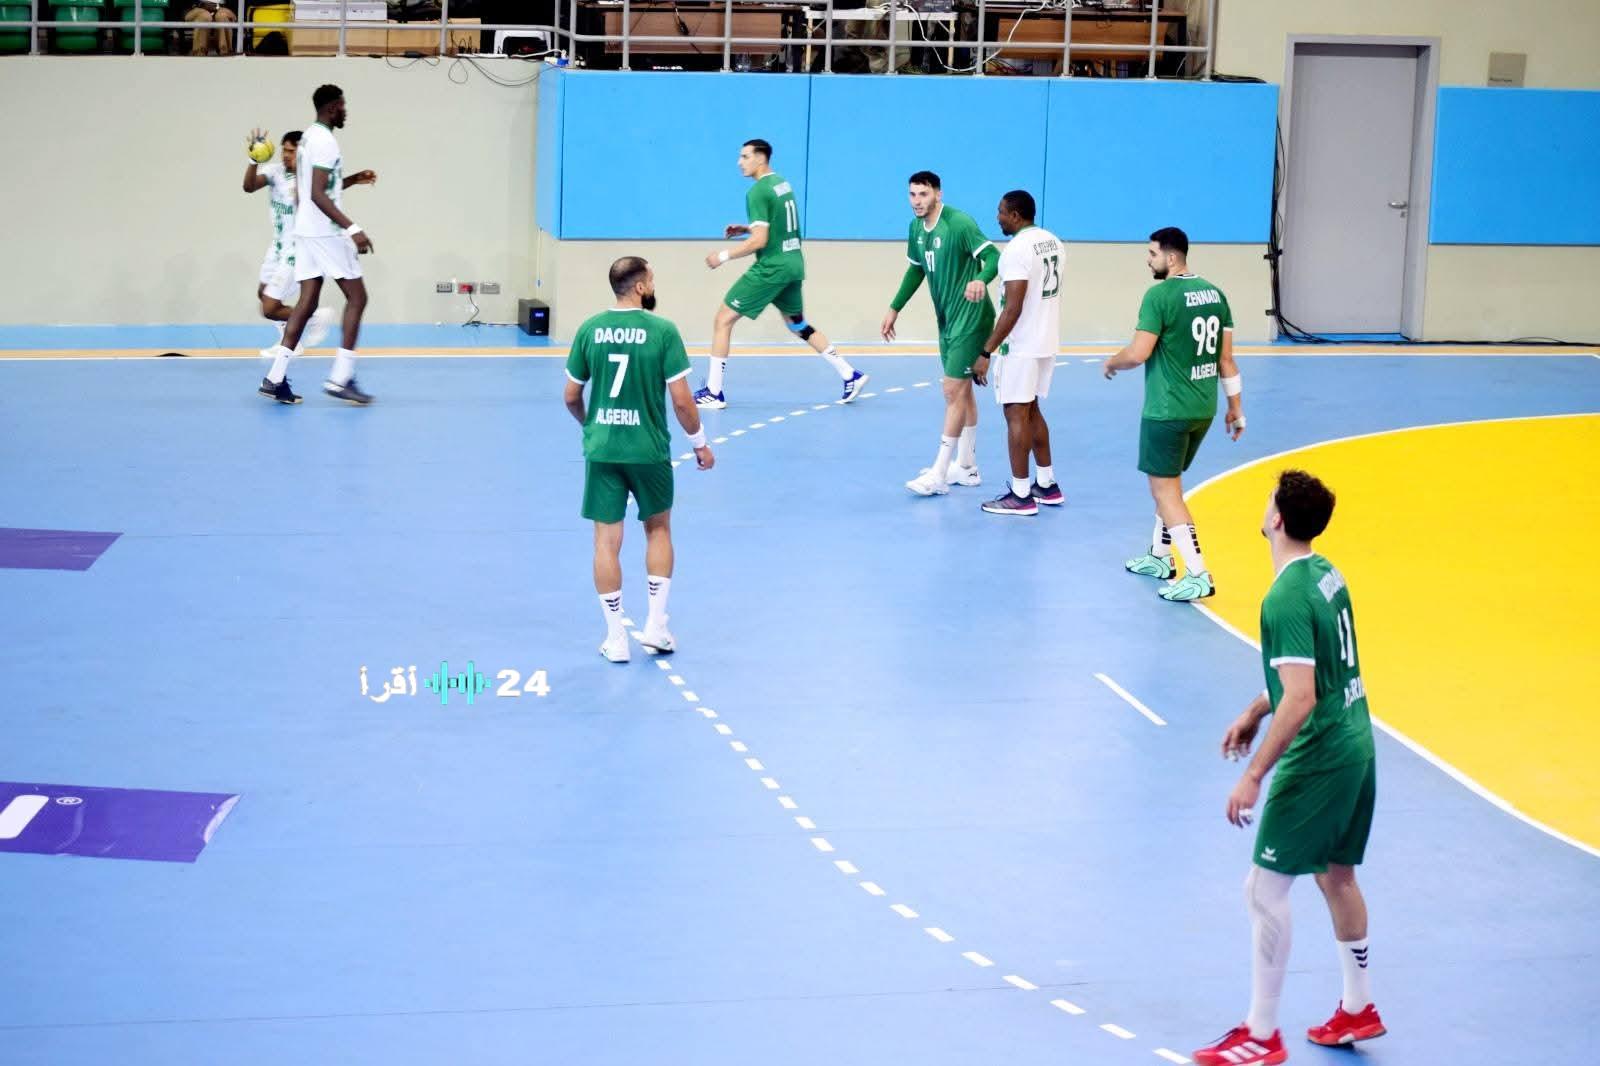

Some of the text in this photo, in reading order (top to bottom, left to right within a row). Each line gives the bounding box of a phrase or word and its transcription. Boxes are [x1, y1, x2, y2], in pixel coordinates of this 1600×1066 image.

[784, 199, 797, 232] 11
[1041, 255, 1060, 299] 23
[594, 327, 647, 344] DAOUD
[1191, 315, 1220, 356] 98
[608, 353, 629, 398] 7
[595, 408, 640, 426] ALGERIA
